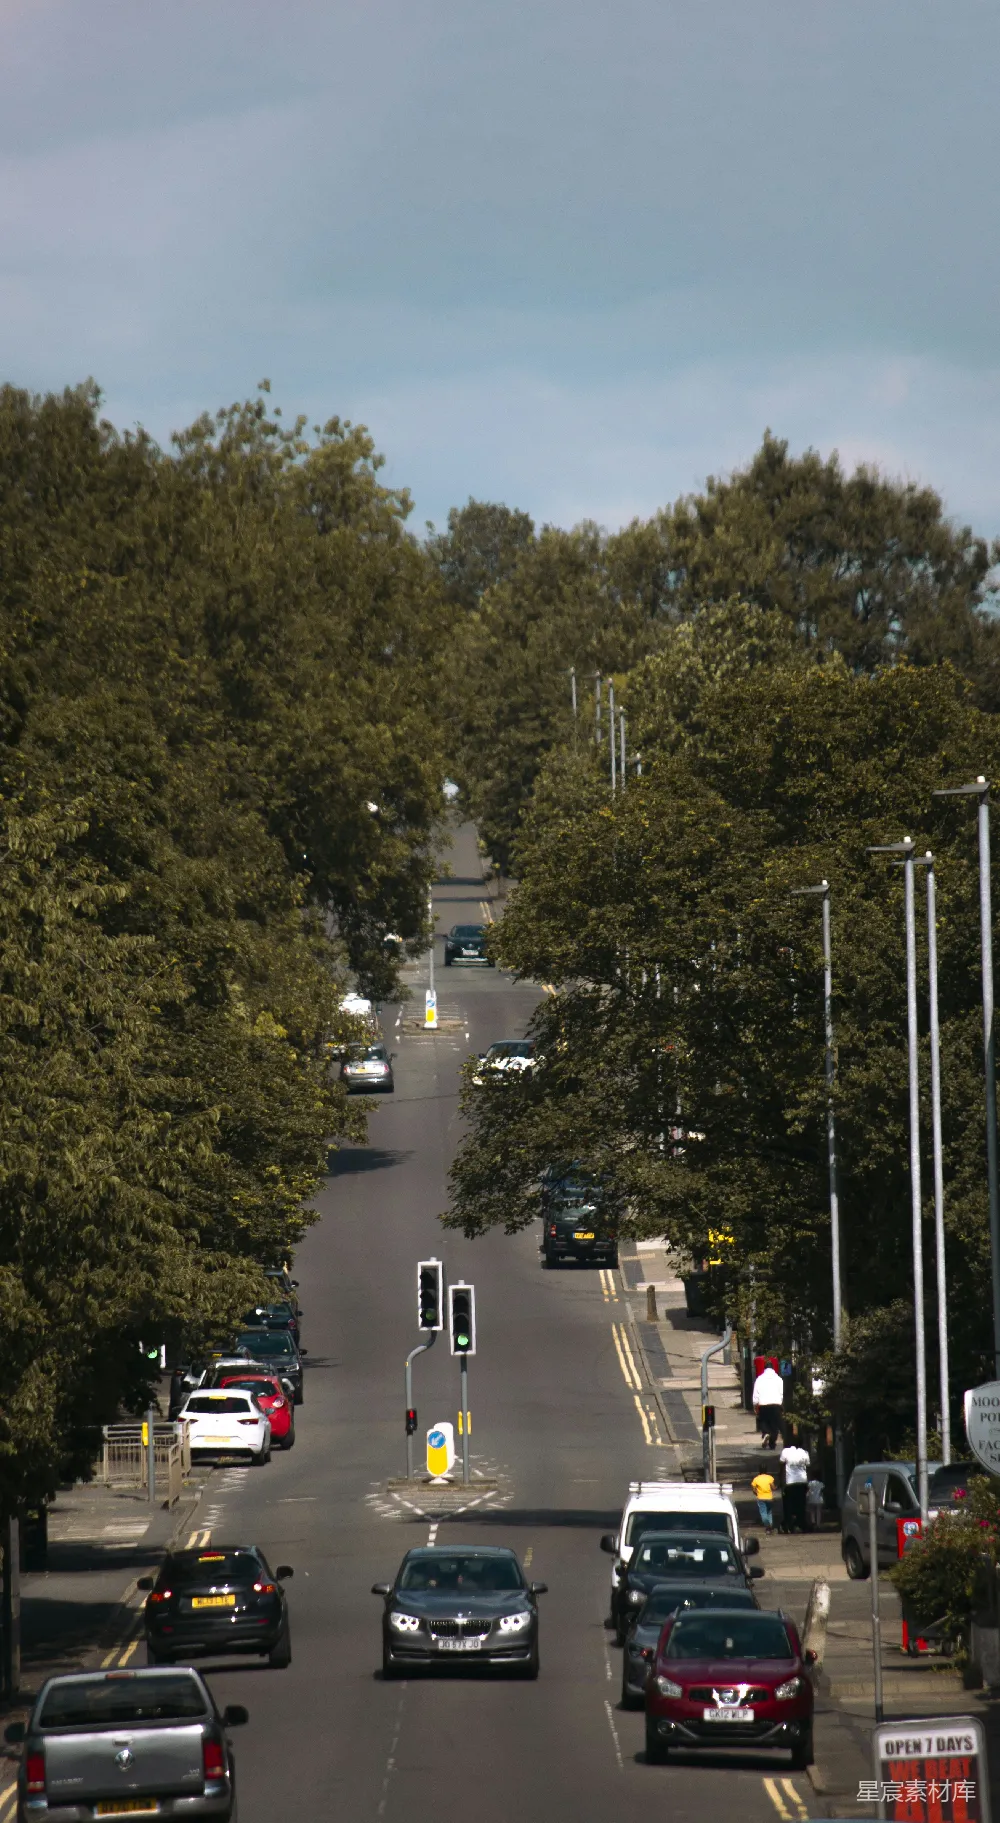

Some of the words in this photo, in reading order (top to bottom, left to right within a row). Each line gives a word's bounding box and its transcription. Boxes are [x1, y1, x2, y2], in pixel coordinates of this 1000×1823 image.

[980, 1412, 1000, 1422] PO
[885, 1738, 922, 1756] OPEN
[925, 1737, 933, 1753] 7
[936, 1735, 974, 1752] DAYS
[888, 1759, 921, 1780] WE
[924, 1757, 972, 1780] BEAT
